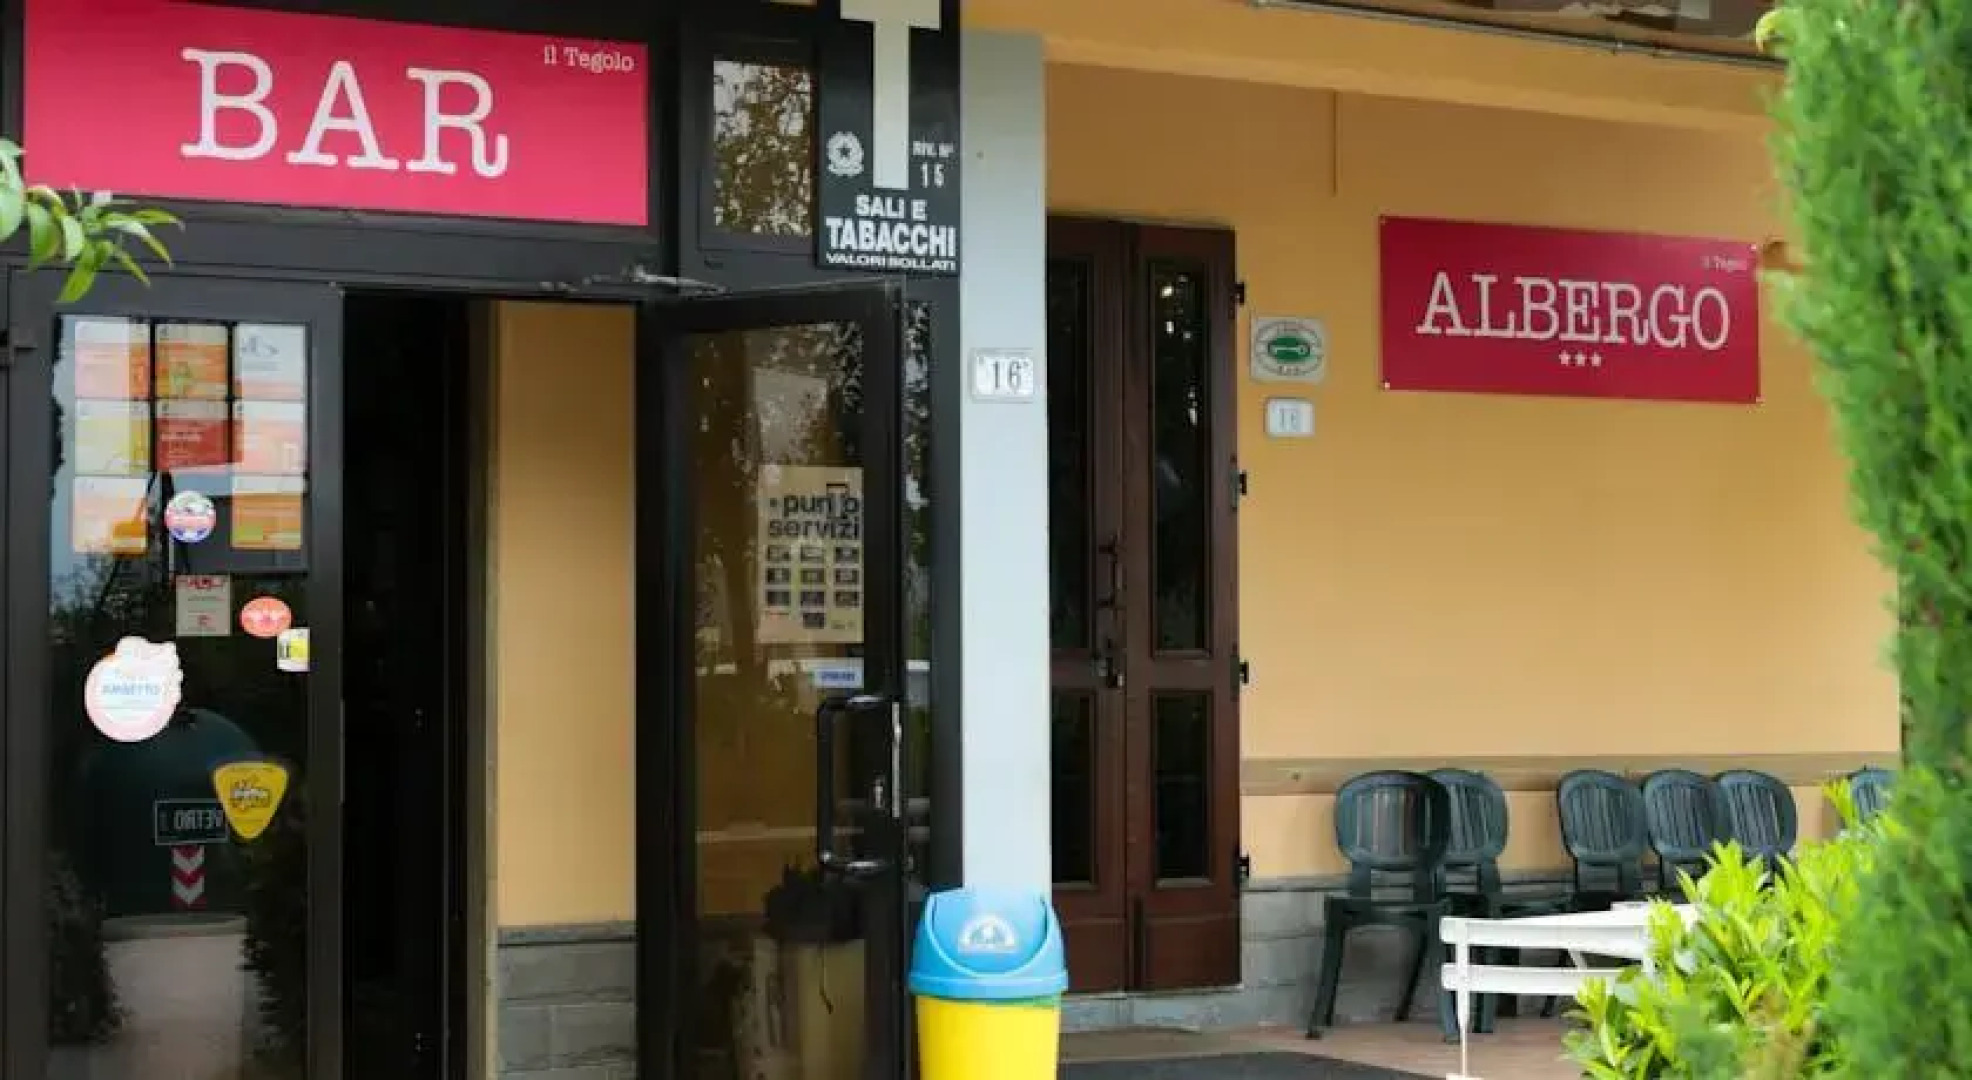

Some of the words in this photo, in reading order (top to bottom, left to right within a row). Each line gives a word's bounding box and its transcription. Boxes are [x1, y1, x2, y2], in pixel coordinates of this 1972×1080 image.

[544, 44, 557, 66] il
[563, 46, 635, 74] Tegolo
[181, 48, 508, 177] BAR
[856, 194, 905, 219] SALI
[911, 199, 927, 221] E
[825, 217, 957, 257] TABACCHI
[826, 253, 885, 267] VALORI
[889, 256, 957, 271] BOLLATI
[1416, 271, 1730, 350] ALBERGO
[992, 360, 1021, 389] 16
[769, 517, 858, 539] servizi
